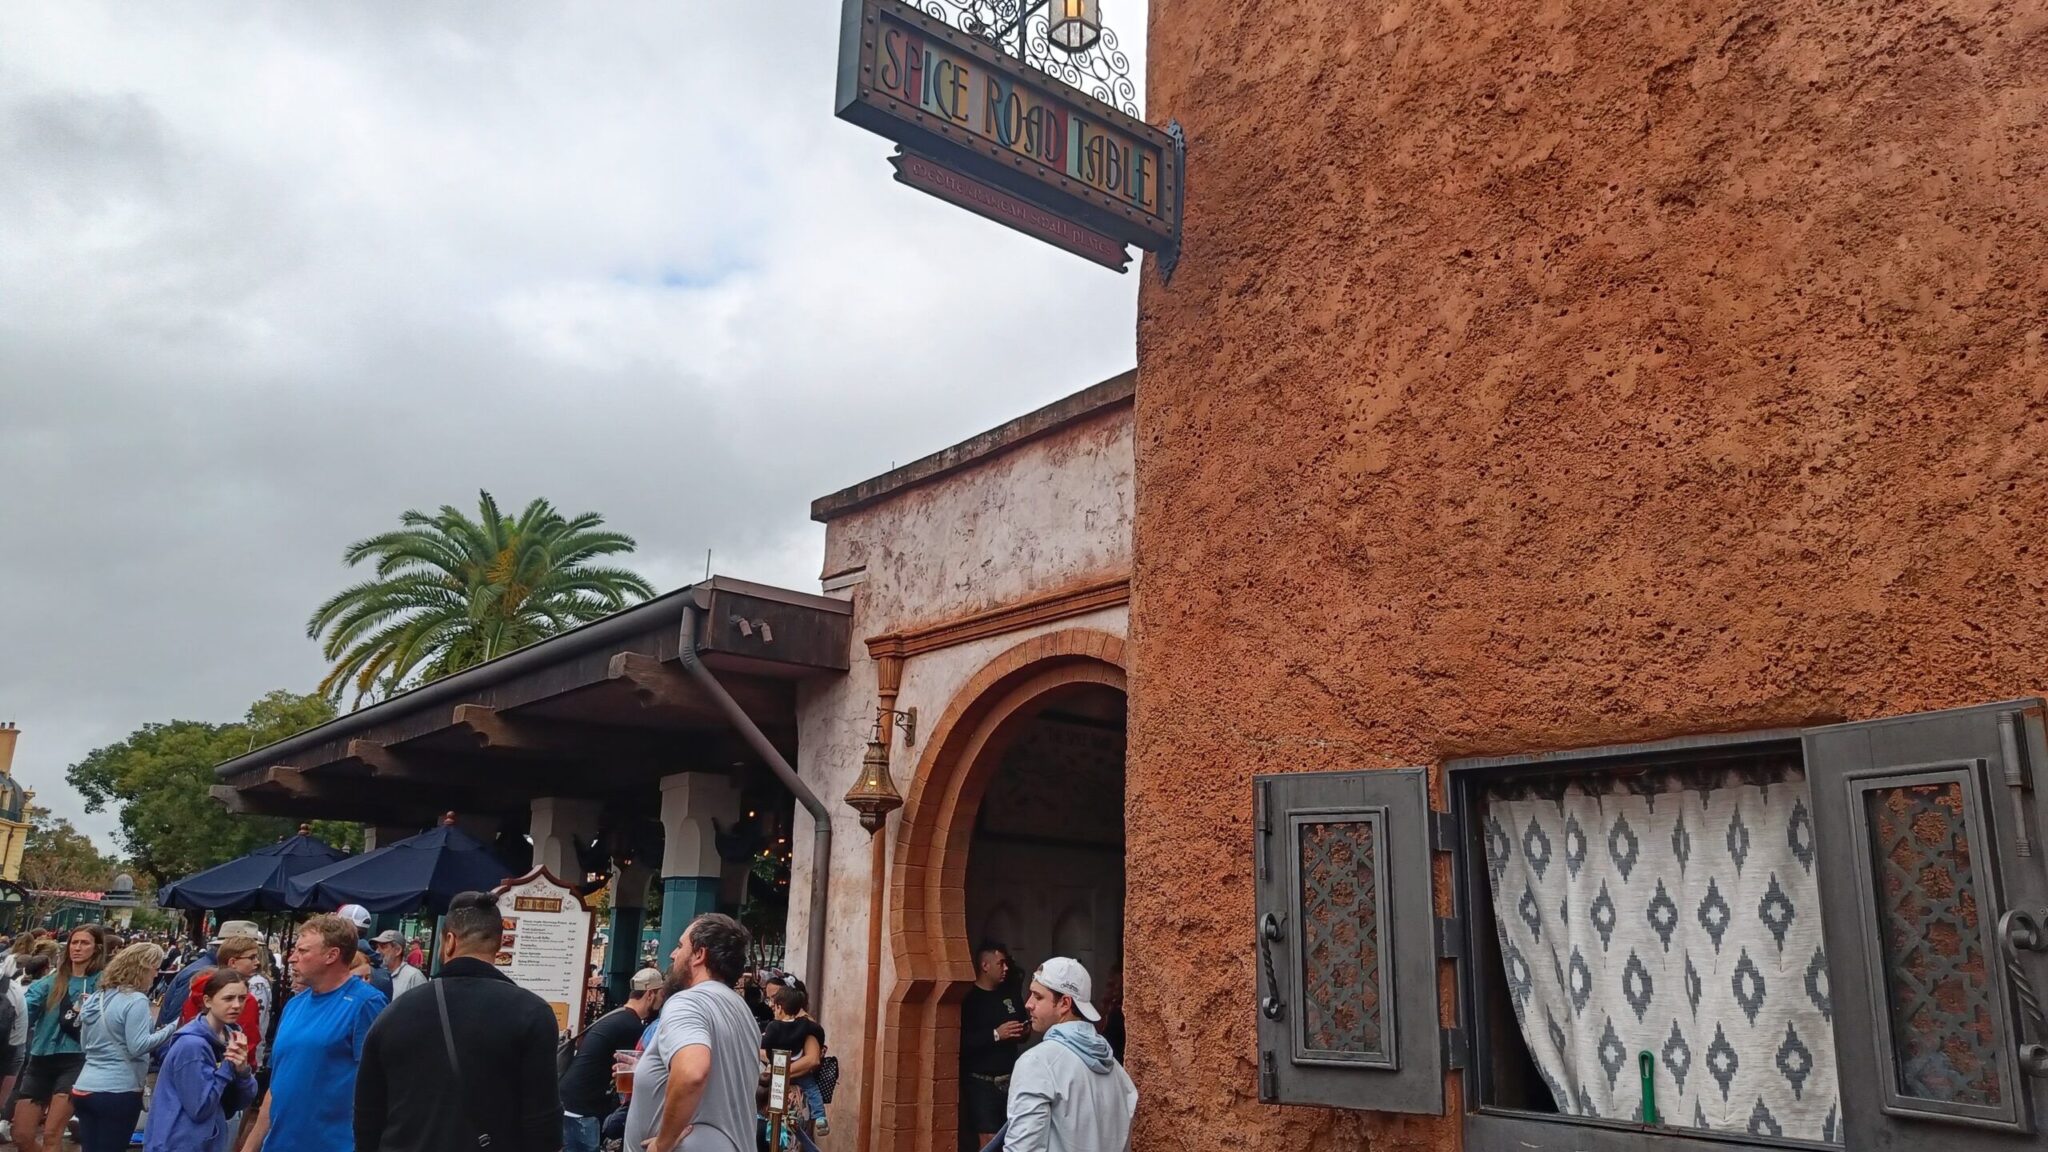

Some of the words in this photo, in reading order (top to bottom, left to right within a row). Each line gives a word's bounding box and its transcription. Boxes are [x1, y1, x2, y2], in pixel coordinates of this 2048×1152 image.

[881, 30, 969, 122] SPICE
[985, 75, 1063, 163] ROAD
[1073, 117, 1152, 206] TABLE
[912, 164, 1026, 220] MEDITERRANEAN
[1030, 214, 1068, 239] SMALL
[1073, 229, 1112, 256] PLATES
